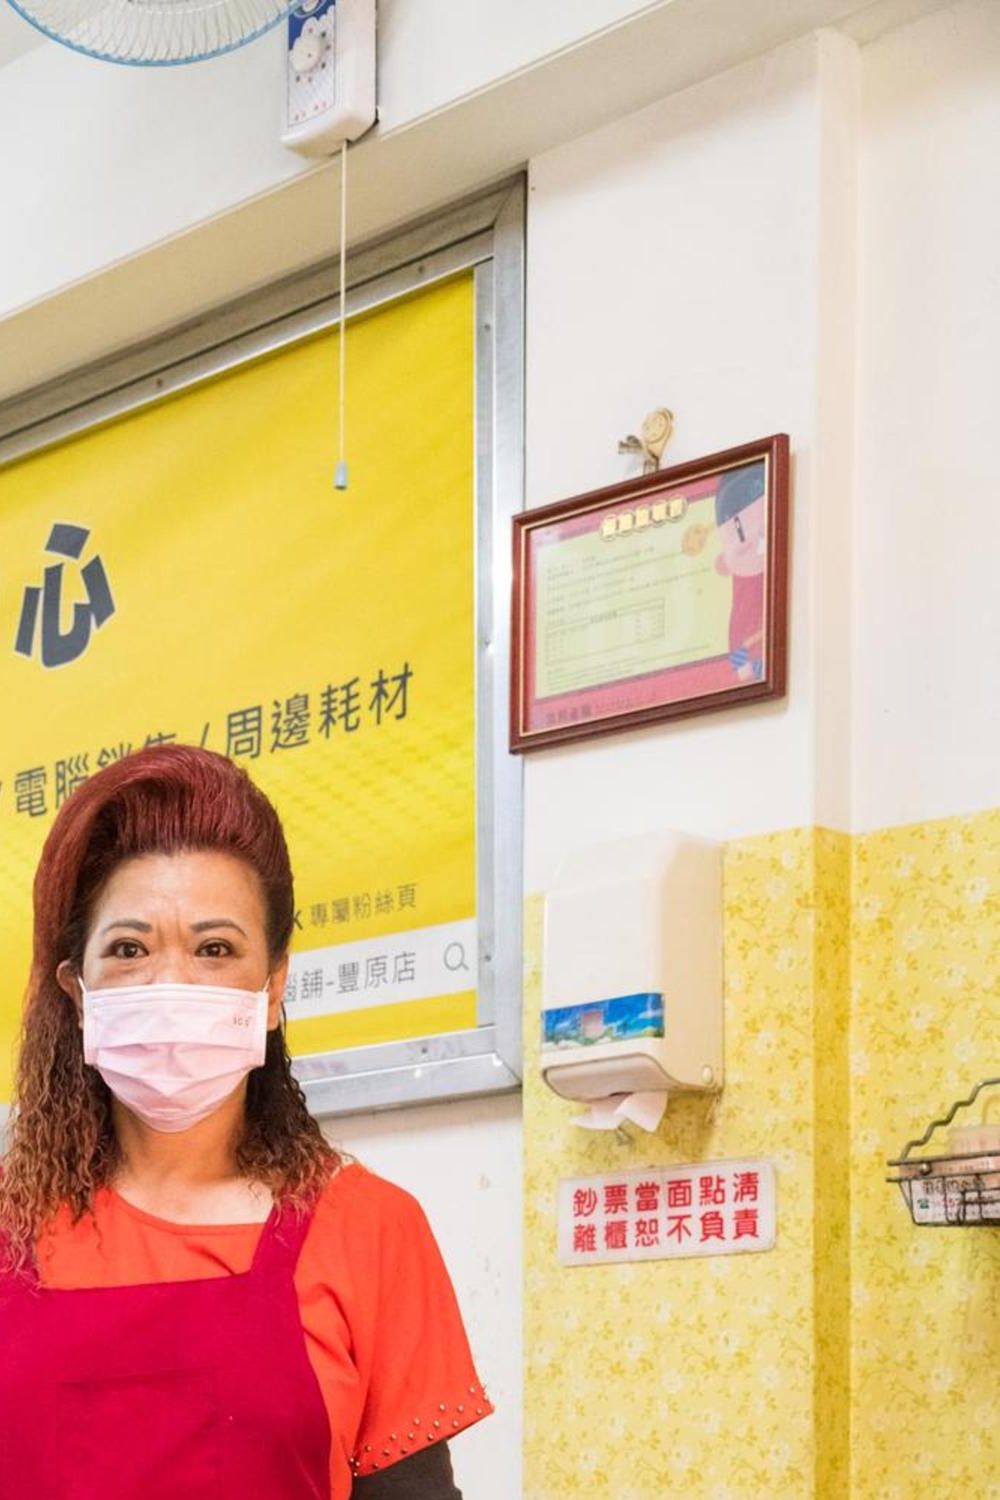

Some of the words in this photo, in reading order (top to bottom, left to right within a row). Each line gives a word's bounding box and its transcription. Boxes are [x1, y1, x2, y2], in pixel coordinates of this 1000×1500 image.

[225, 661, 414, 760] 周邊耗材
[311, 882, 417, 929] 專屬粉絲頁
[573, 1171, 760, 1218] 鈔票當面點清
[573, 1208, 760, 1254] 離櫃恕不負責
